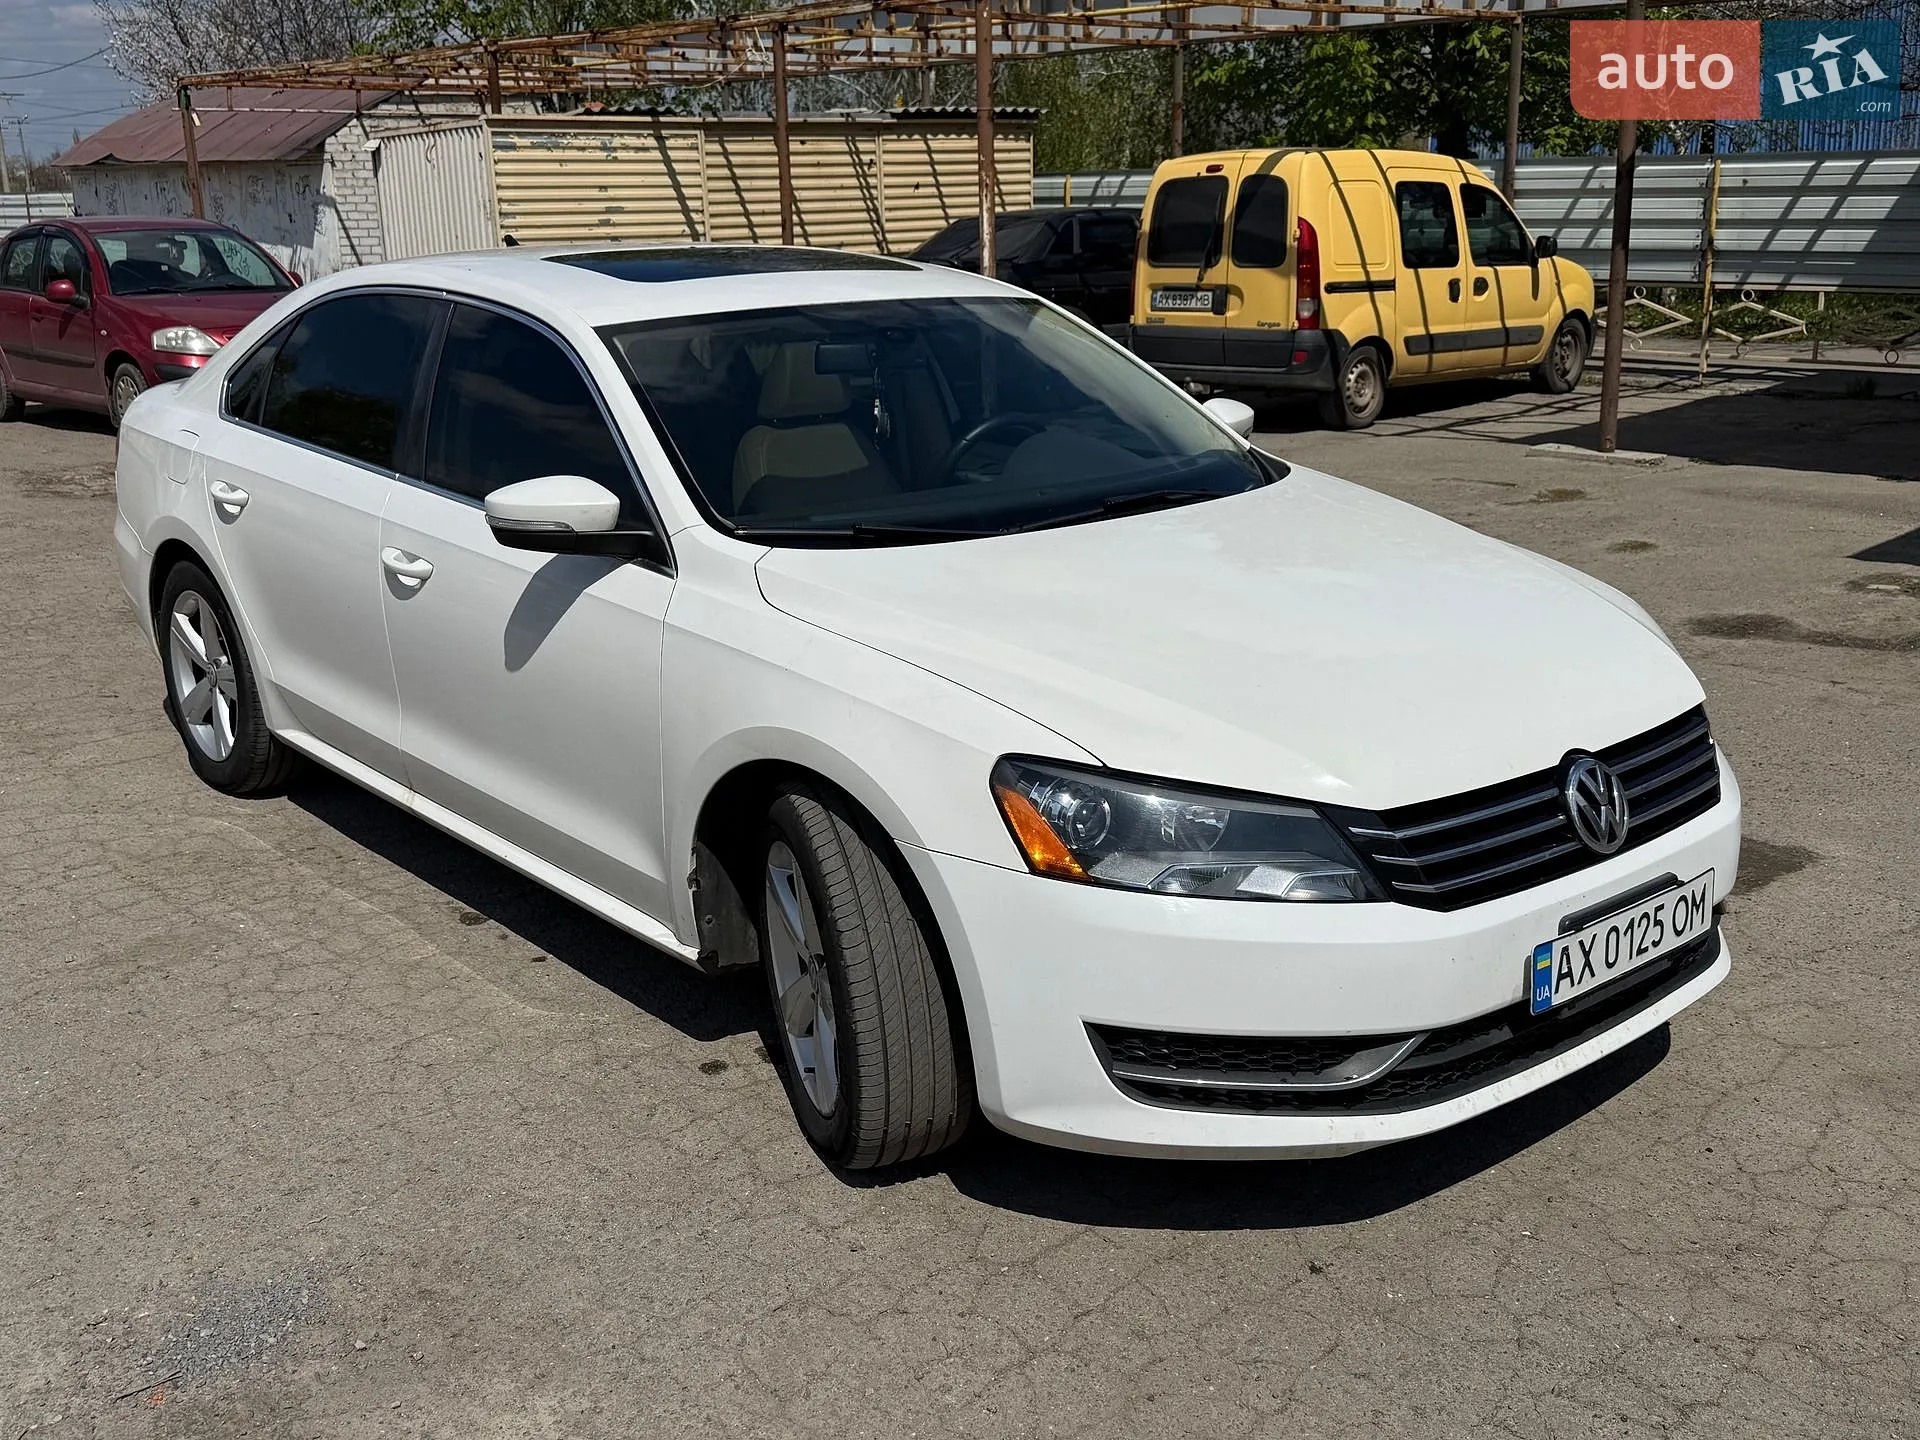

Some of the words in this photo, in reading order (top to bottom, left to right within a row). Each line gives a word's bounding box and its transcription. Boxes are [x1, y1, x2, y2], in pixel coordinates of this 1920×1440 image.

[1158, 294, 1170, 306] AX
[1195, 294, 1210, 306] MB
[1554, 932, 1597, 995] AX
[1604, 903, 1665, 970] 0125
[1672, 883, 1707, 937] OM
[1536, 986, 1551, 1001] UA
